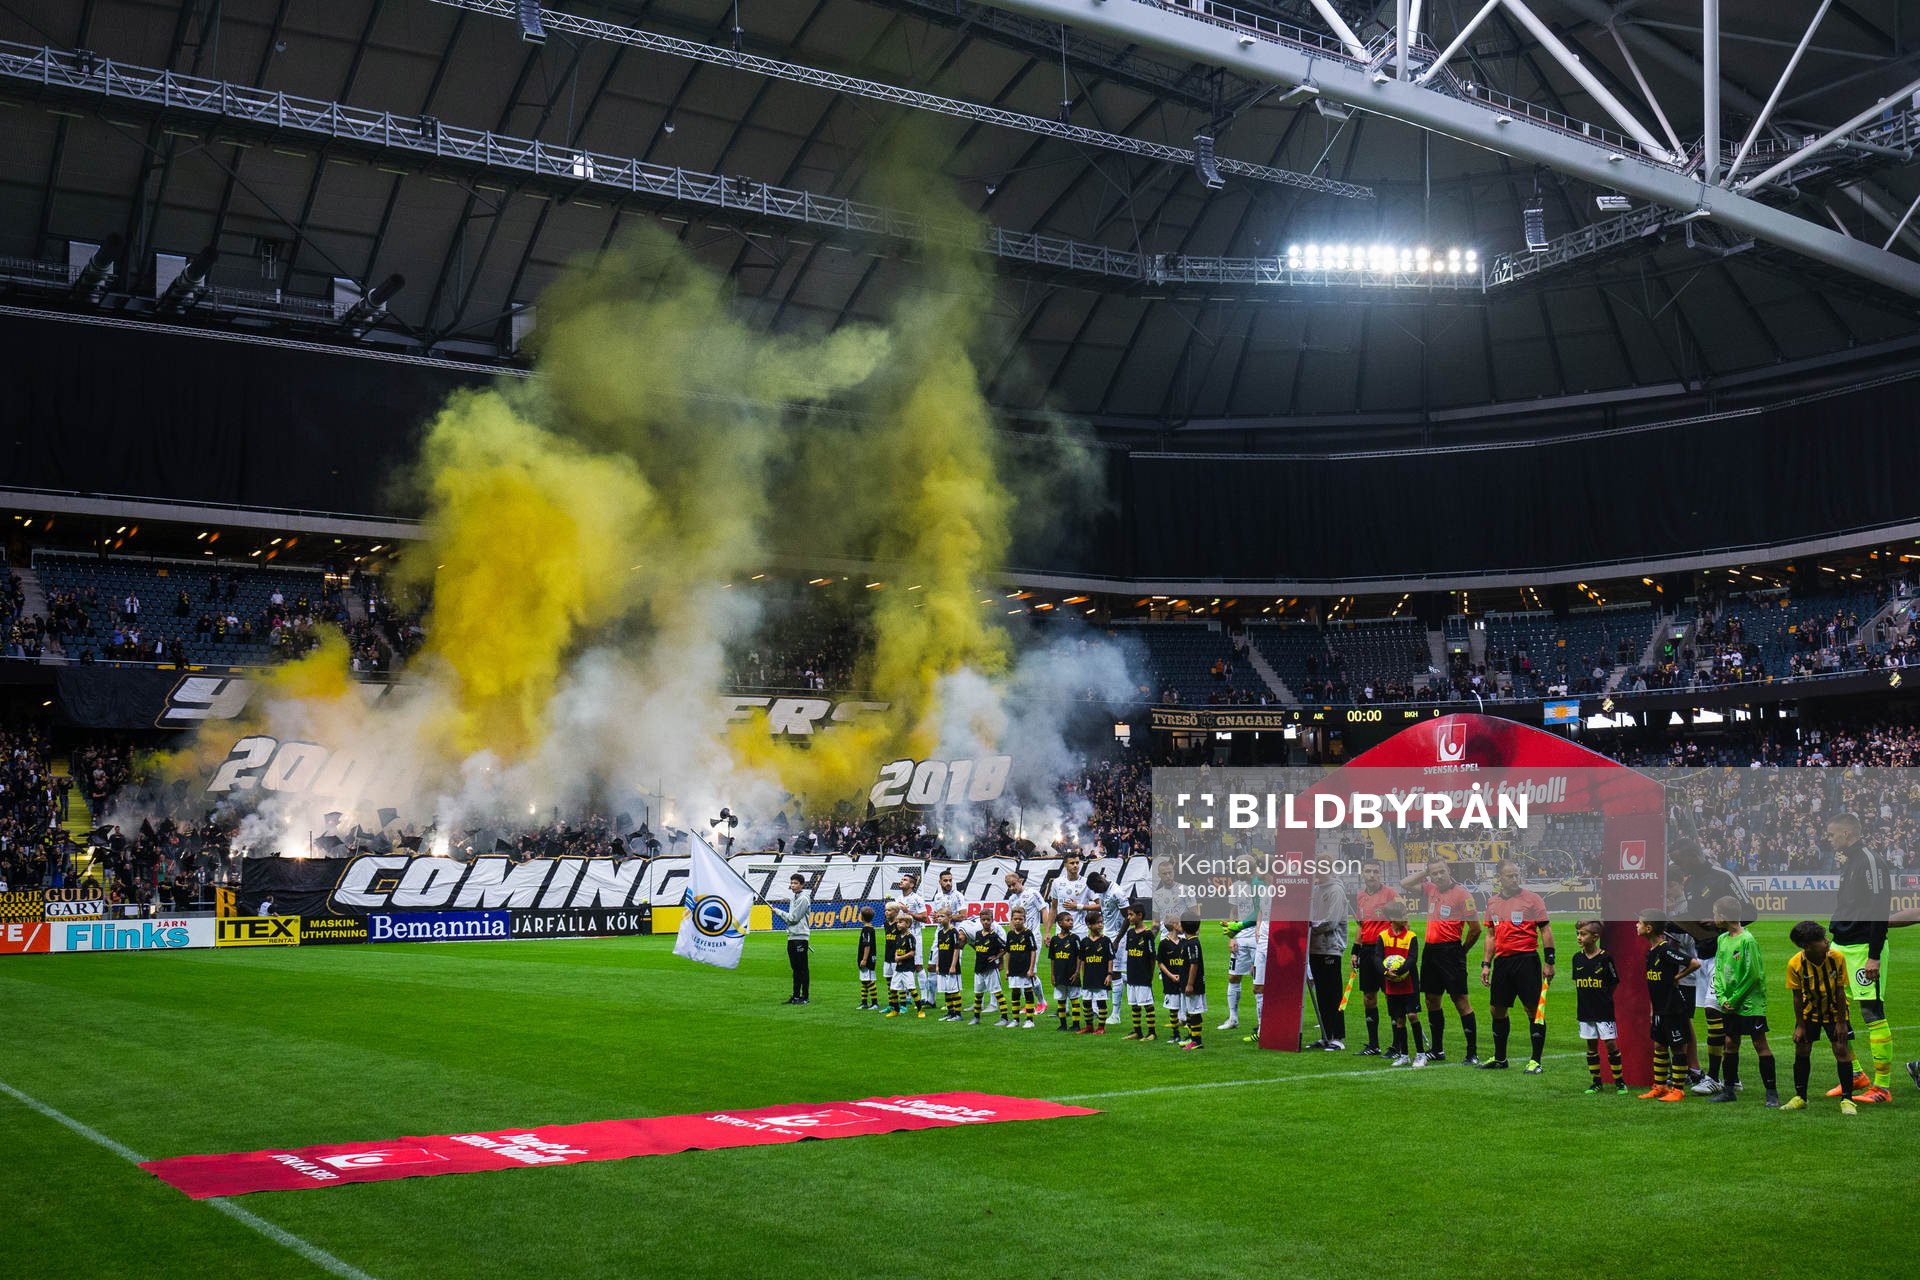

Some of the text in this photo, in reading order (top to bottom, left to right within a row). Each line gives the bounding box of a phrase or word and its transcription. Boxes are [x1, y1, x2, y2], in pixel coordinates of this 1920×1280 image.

[1152, 713, 1198, 725] TYRESÖ
[1216, 715, 1283, 726] GNAGARE
[1347, 710, 1382, 722] 00:00
[1433, 709, 1440, 717] 0
[1423, 763, 1480, 775] SVENSKA SPEL
[868, 755, 1012, 808] 2018
[1434, 782, 1494, 810] svenk
[334, 854, 691, 909] COMING
[1607, 872, 1658, 881] SVENSKA SPEL
[45, 888, 102, 901] GULD
[46, 902, 102, 915] GARY
[218, 918, 294, 939] ITEX
[310, 919, 359, 928] MASKIN-
[372, 912, 506, 940] Bemannia
[512, 913, 639, 934] JÄRFÄLLA KÖK
[66, 922, 190, 950] Flinks
[301, 929, 368, 939] UTHYRNING
[1086, 954, 1104, 964] notar
[1169, 956, 1185, 966] noar
[1576, 976, 1603, 988] notar
